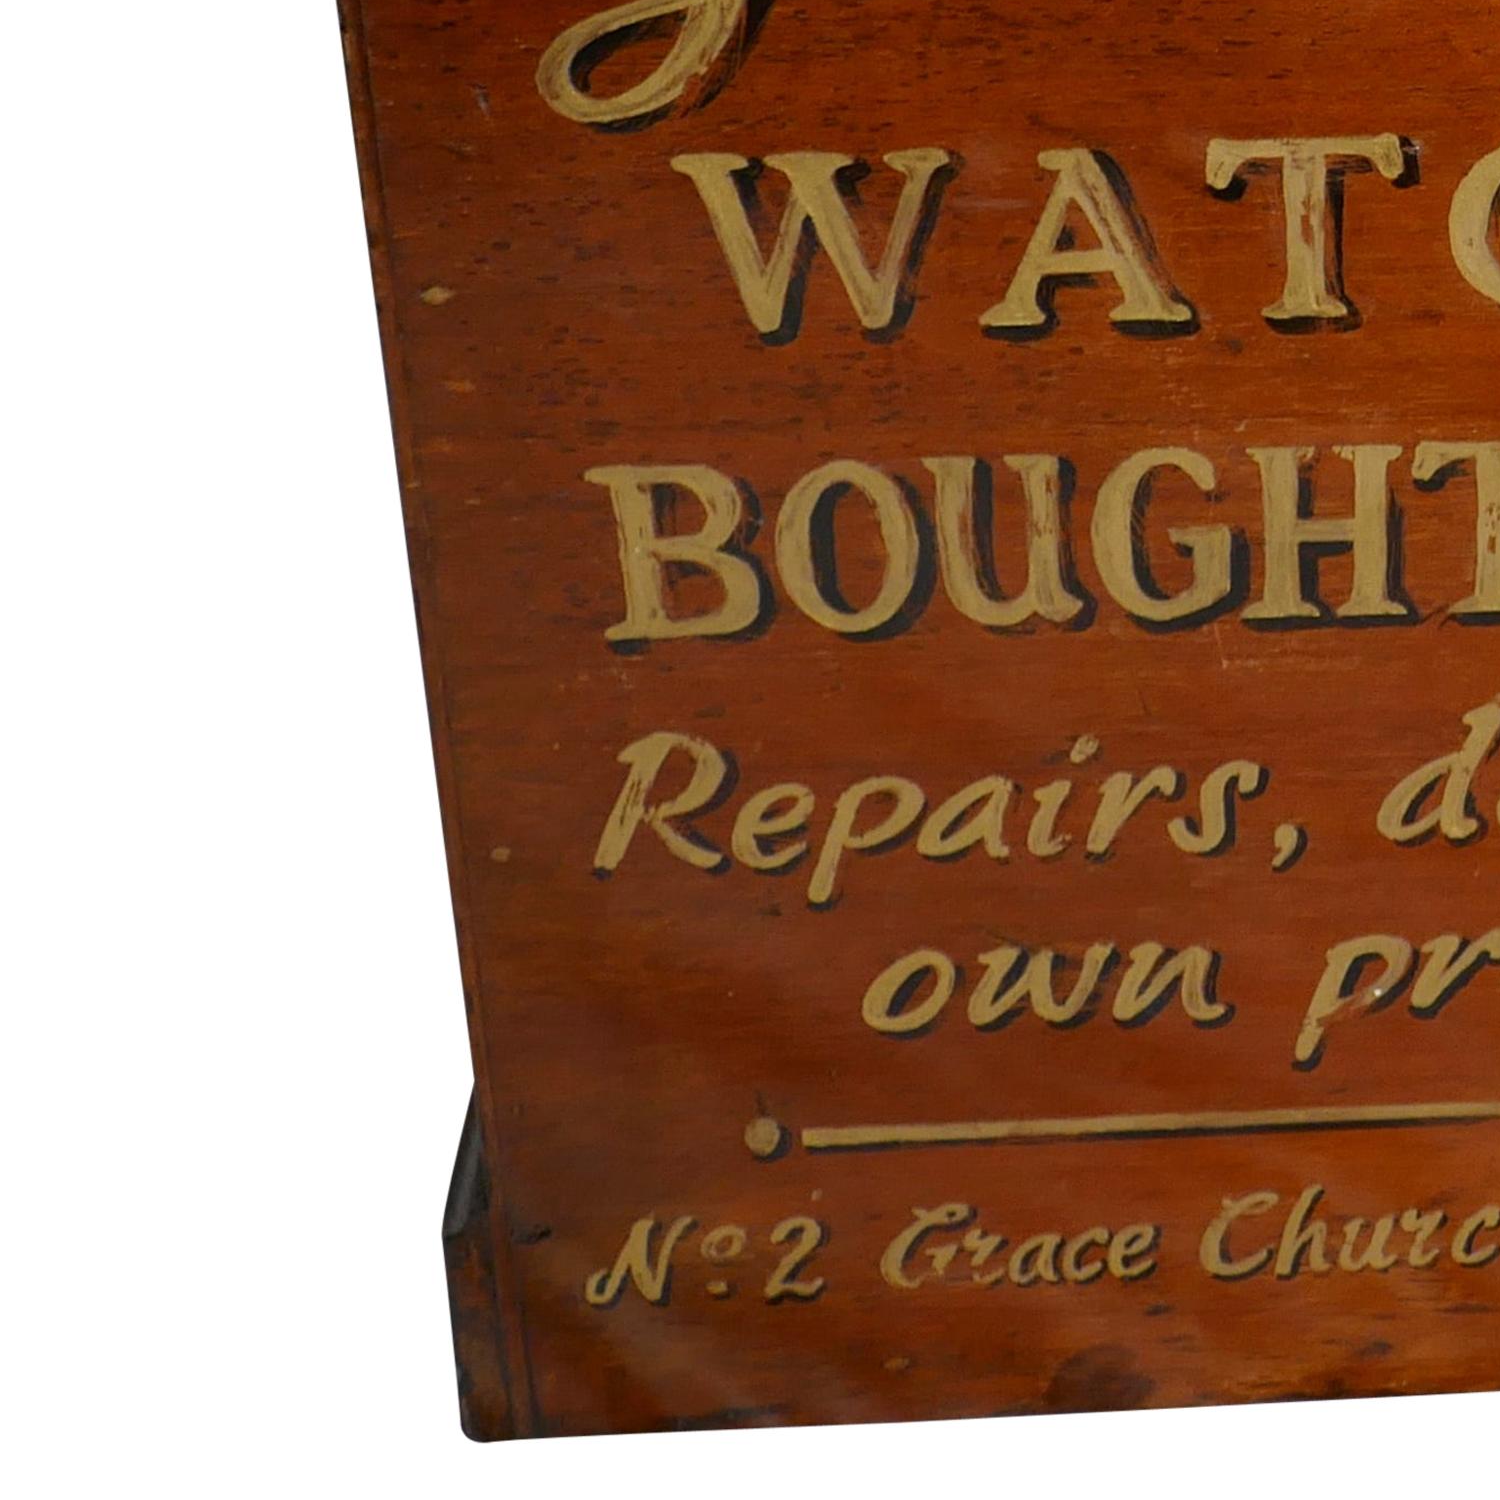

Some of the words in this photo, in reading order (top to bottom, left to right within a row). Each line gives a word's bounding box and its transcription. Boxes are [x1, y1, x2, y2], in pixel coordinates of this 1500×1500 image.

[595, 732, 1304, 904] Repairs,
[863, 943, 1224, 1033] own
[882, 1204, 1154, 1287] Grace
